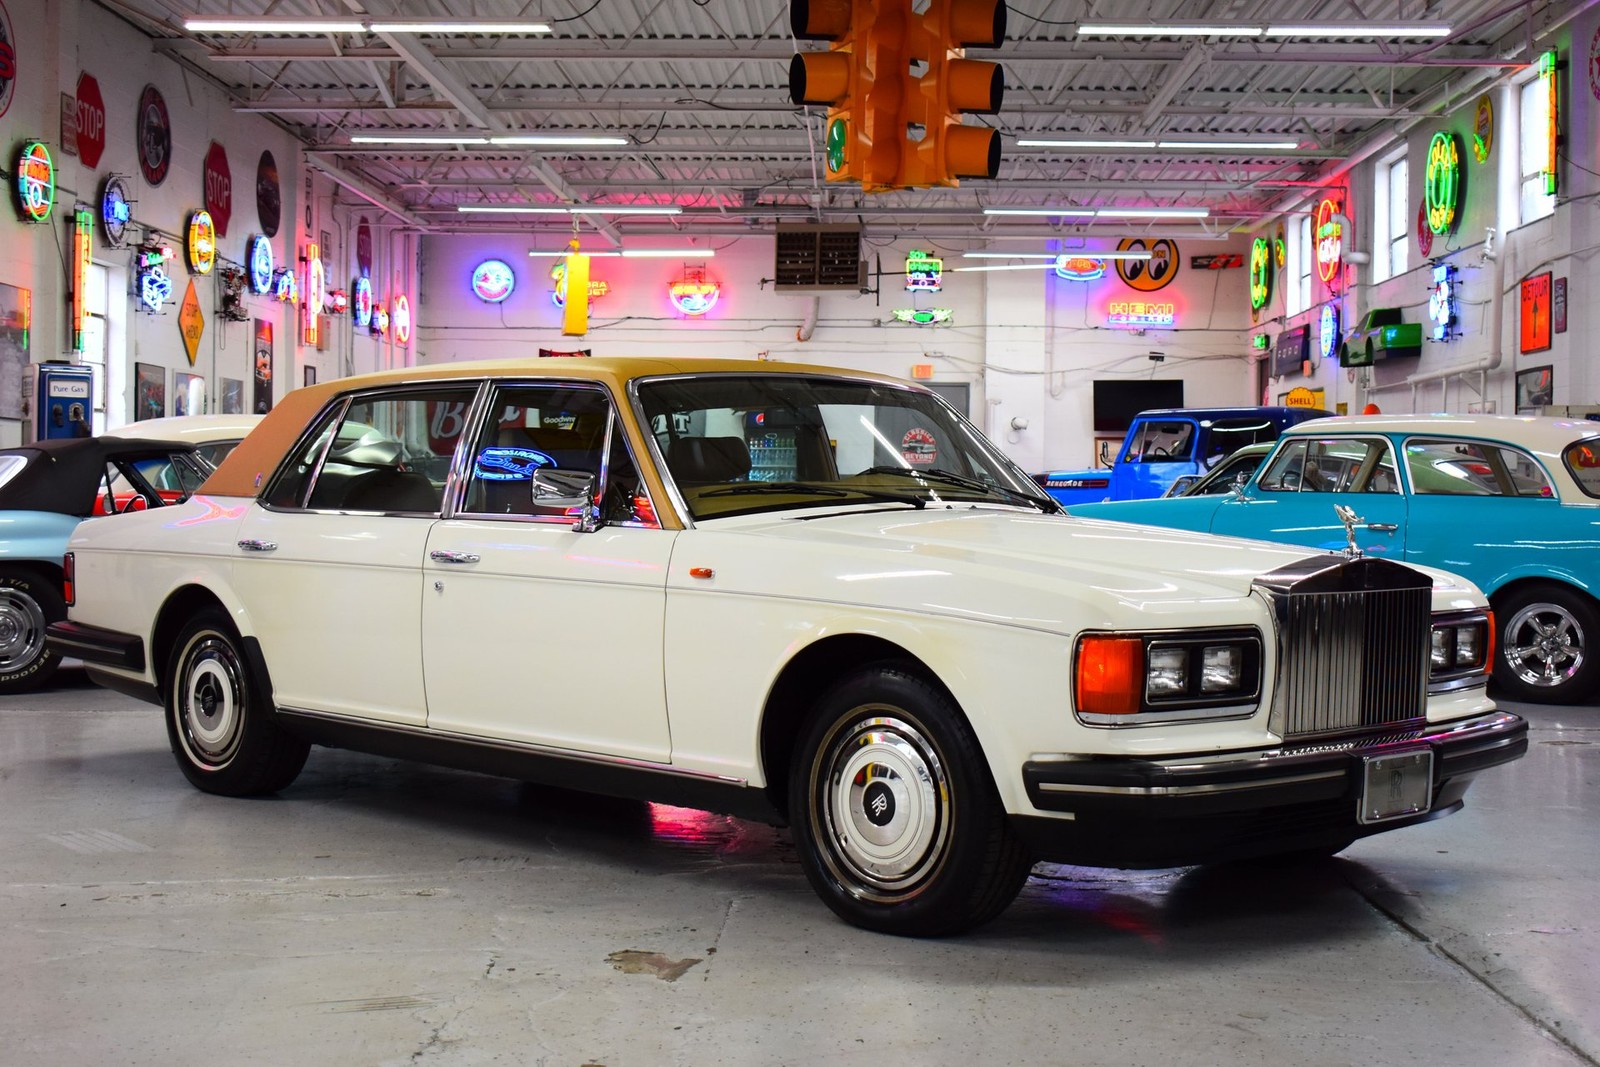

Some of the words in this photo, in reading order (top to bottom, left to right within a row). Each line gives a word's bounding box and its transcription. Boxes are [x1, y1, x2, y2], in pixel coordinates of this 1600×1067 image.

[77, 99, 104, 141] STOP
[207, 168, 231, 208] STOP
[1522, 279, 1549, 302] DETOUR
[1109, 302, 1174, 315] HEMI
[1278, 345, 1299, 359] FORD
[53, 385, 69, 393] Pure
[71, 385, 84, 393] Gas
[1289, 397, 1312, 405] SHELL
[904, 428, 934, 443] CLASSICS
